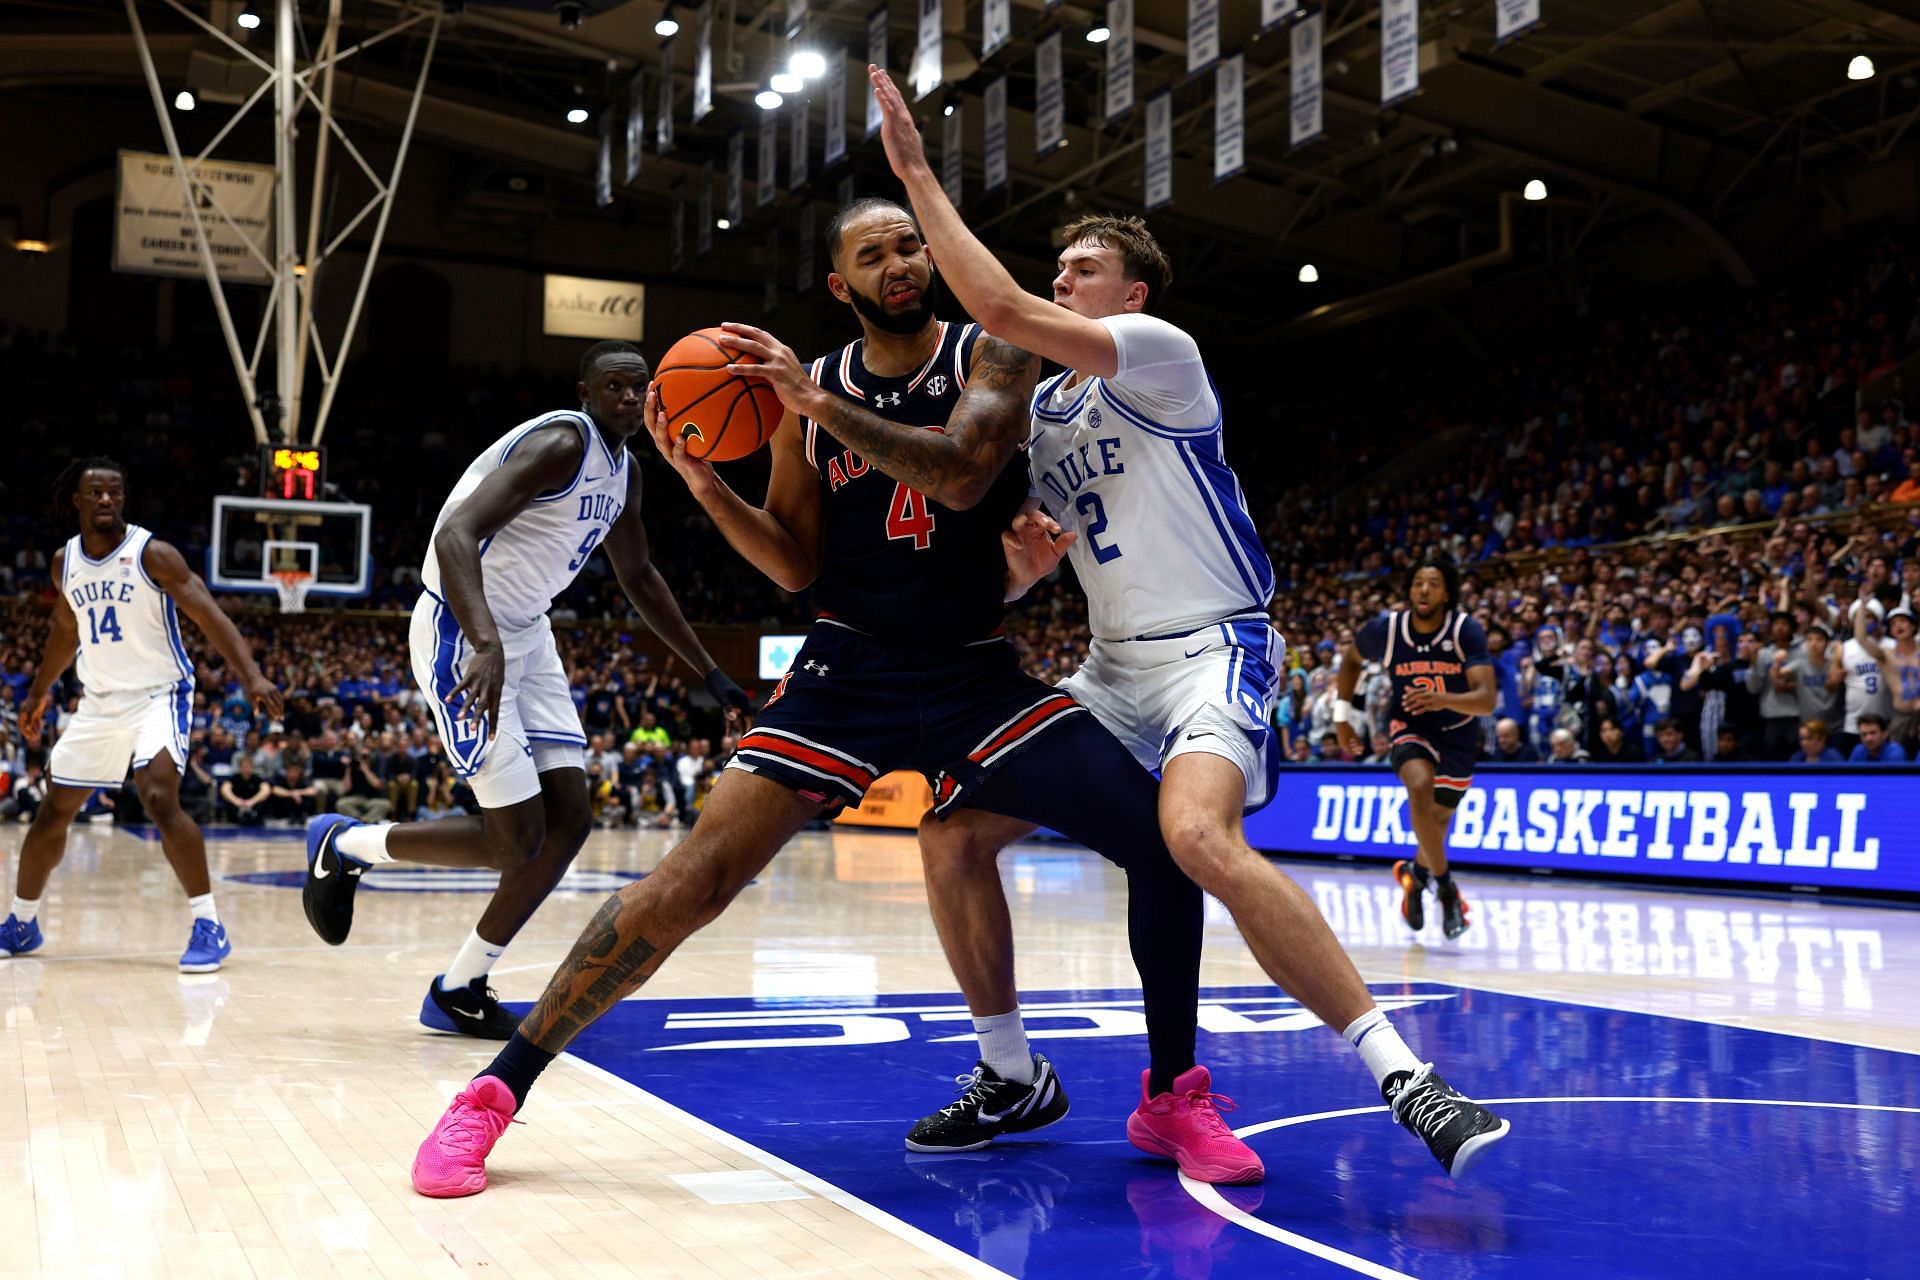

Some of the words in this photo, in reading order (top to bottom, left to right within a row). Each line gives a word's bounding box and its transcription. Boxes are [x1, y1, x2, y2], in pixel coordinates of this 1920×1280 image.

[926, 375, 948, 397] SEC
[284, 467, 315, 500] 17
[1041, 437, 1125, 503] DUKE
[886, 481, 935, 550] 4
[1076, 491, 1123, 565] 2
[567, 528, 602, 571] 9
[71, 580, 135, 608] DUKE
[87, 606, 123, 644] 14
[1395, 660, 1462, 676] AUBURN
[1312, 784, 1419, 846] DUK
[1448, 786, 1880, 871] BASKETBALL
